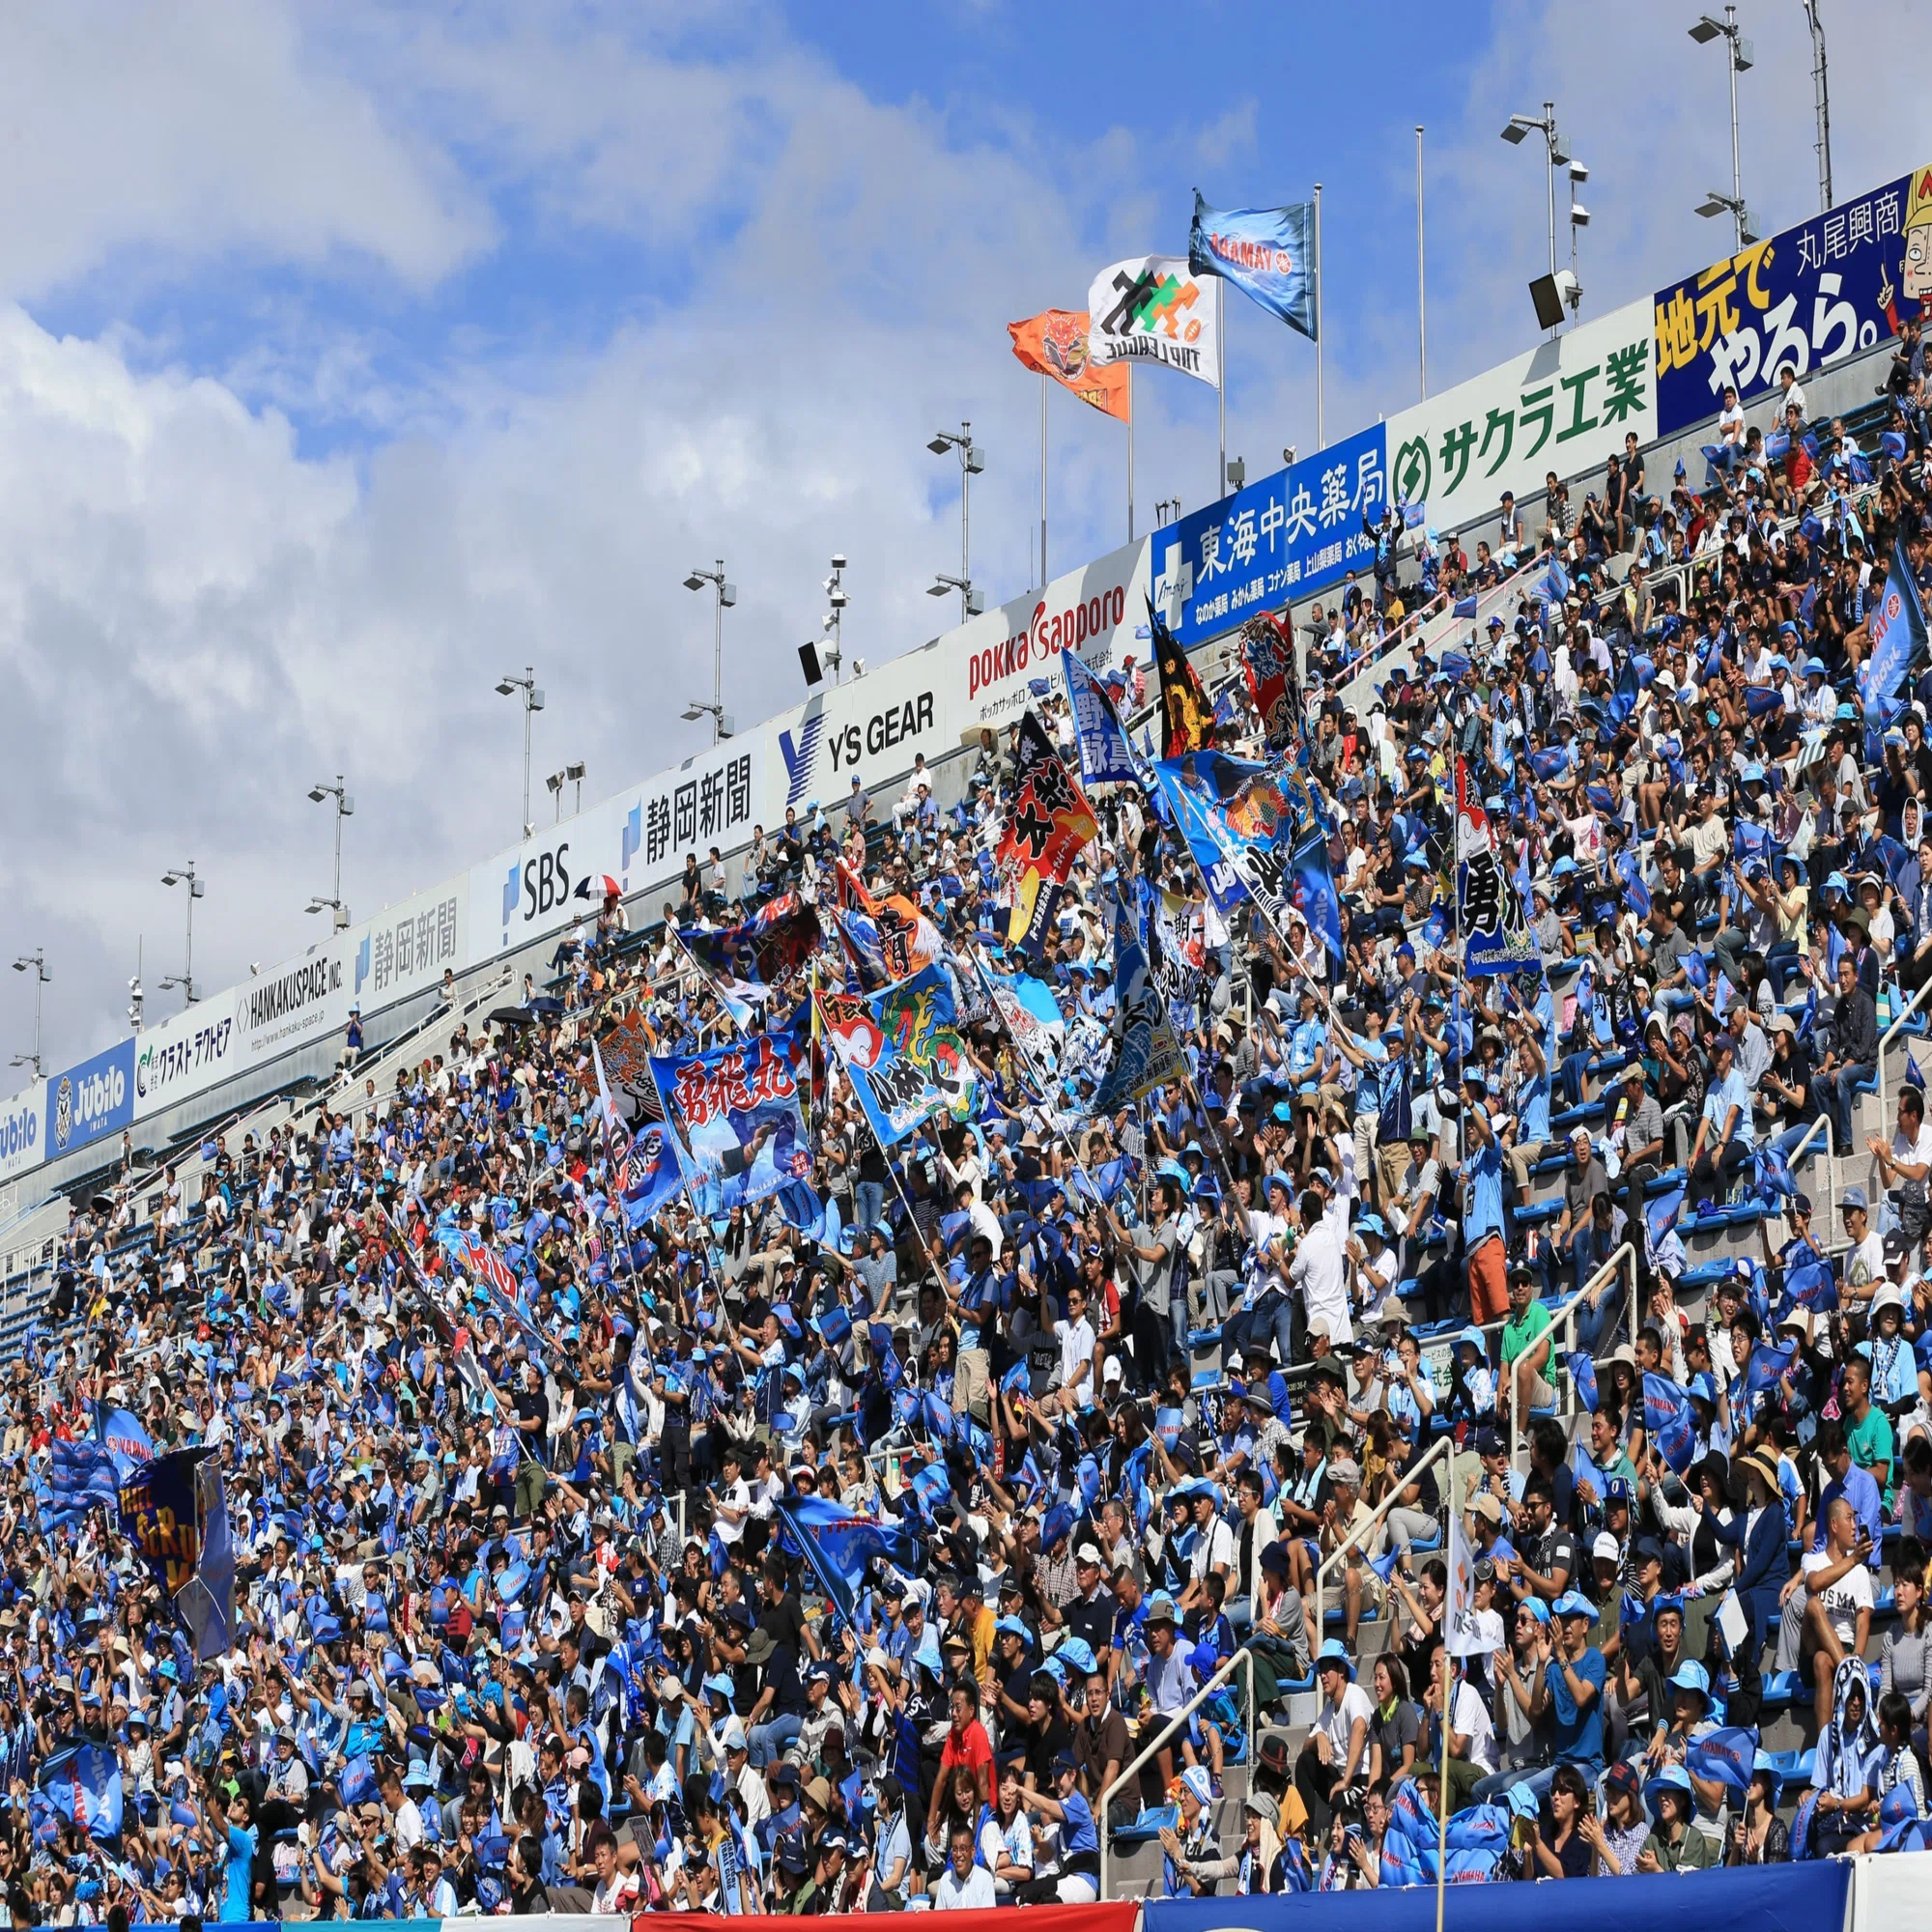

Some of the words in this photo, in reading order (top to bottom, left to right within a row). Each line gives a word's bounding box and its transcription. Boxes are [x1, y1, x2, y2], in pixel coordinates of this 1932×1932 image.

[1797, 190, 1900, 276] 丸尾興商
[1655, 238, 1776, 381] 地元で
[1439, 338, 1649, 498] サクラ工業
[1196, 448, 1384, 584] 東海中央薬局
[1195, 592, 1229, 626] なのか薬局
[1231, 576, 1264, 611] みかん薬局
[1267, 559, 1301, 593] コナン薬局
[1303, 541, 1343, 579] 上山梨薬局
[867, 691, 935, 756] GEAR
[646, 753, 751, 866] 静岡新聞
[525, 842, 570, 922] SBS
[375, 895, 457, 992] 静岡新聞
[251, 956, 327, 1030] HANKAKUSPACE
[328, 960, 343, 993] INC.
[159, 1037, 192, 1086] クラスト
[195, 1017, 232, 1068] テクトピア
[89, 1116, 108, 1134] IWATA
[119, 1436, 154, 1461] YAMAH
